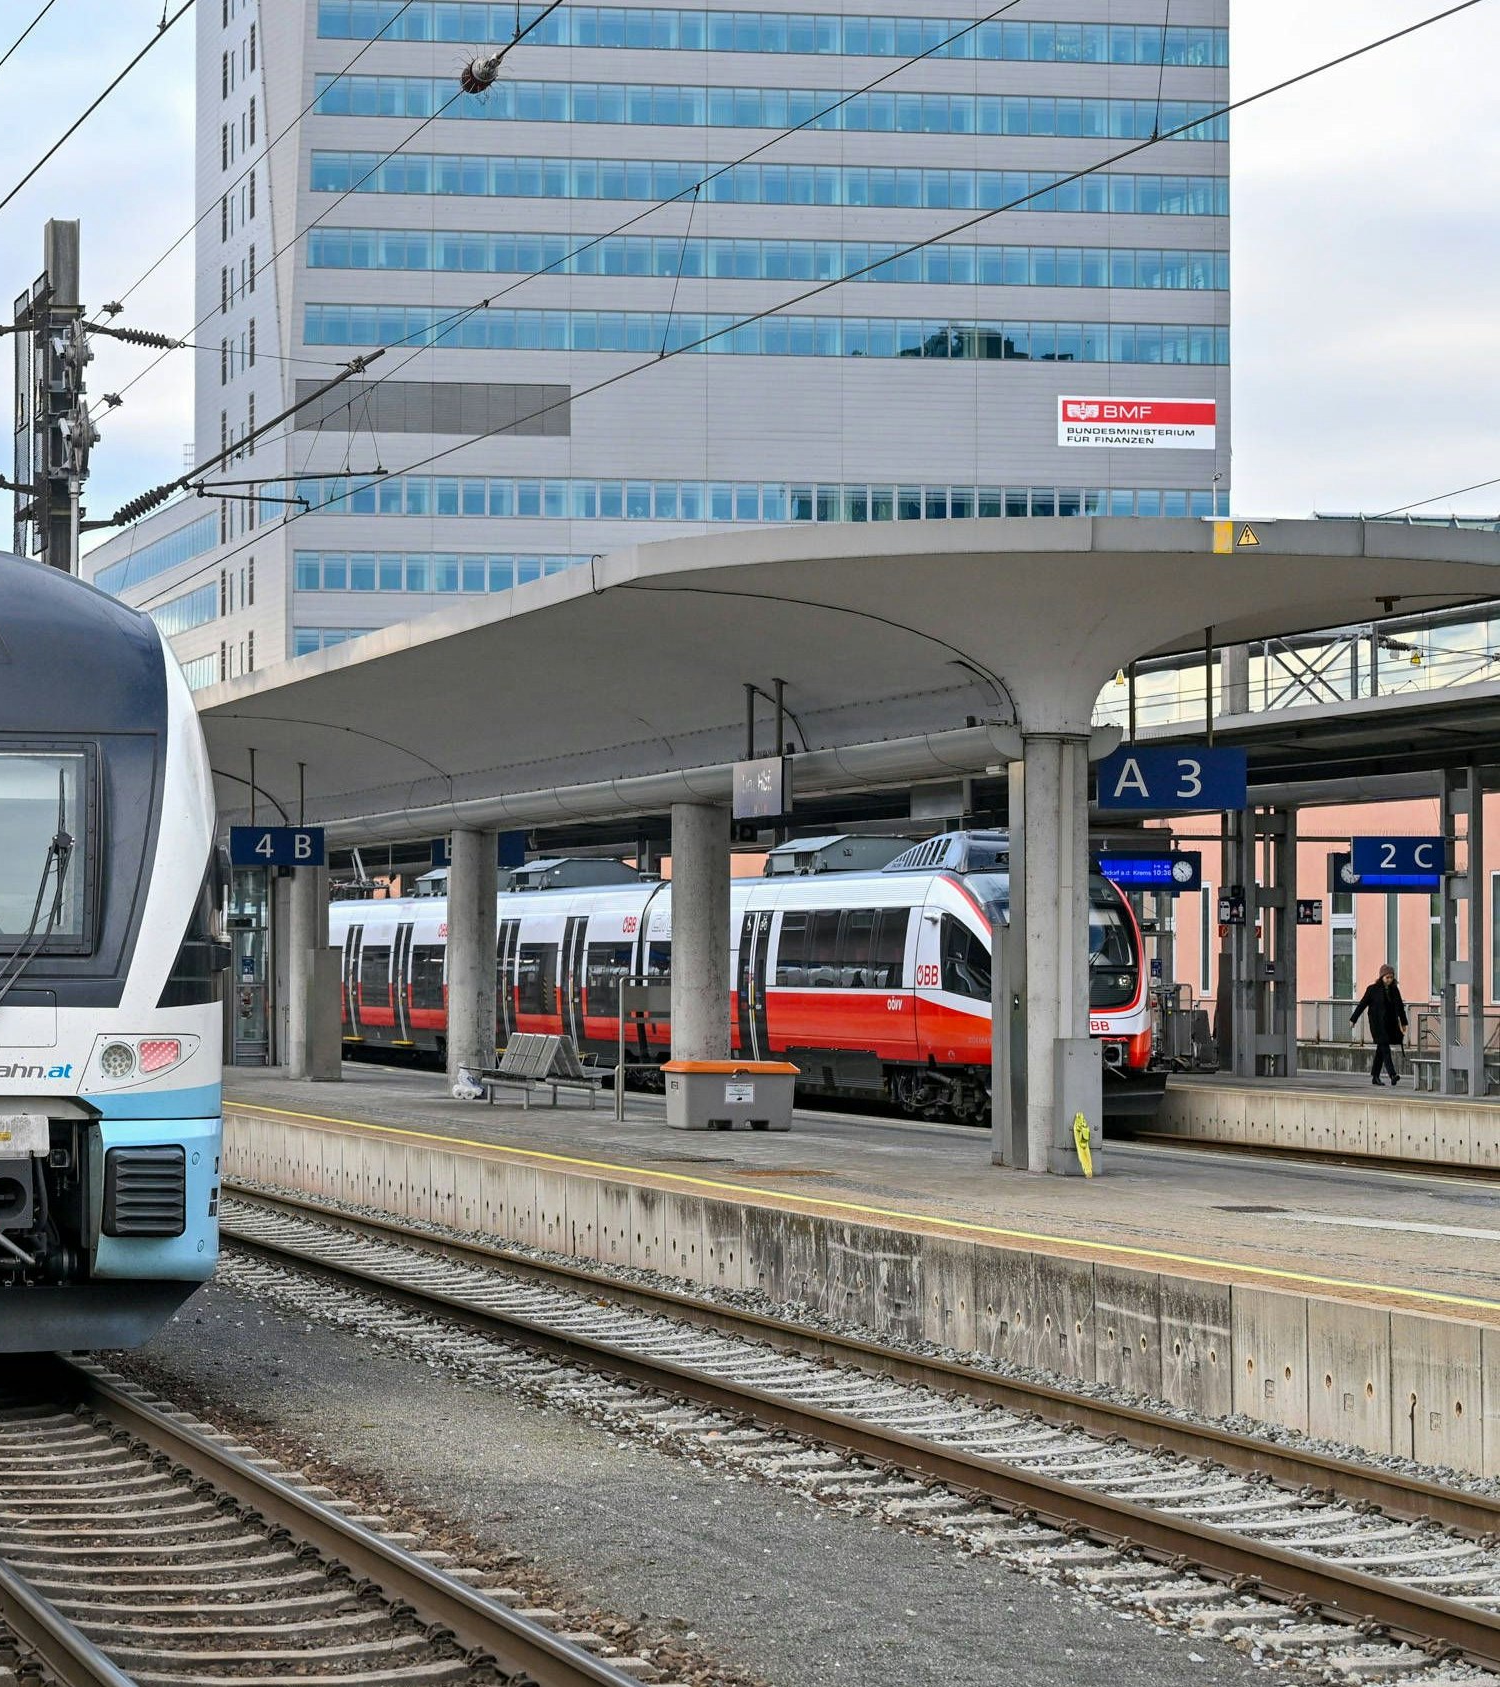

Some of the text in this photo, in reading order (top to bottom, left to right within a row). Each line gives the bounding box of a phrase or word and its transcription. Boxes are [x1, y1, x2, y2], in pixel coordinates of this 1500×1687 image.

[1103, 405, 1152, 419] BMF
[1067, 427, 1195, 437] BUNDESMINISTERIUM
[1067, 434, 1154, 444] FÜR FINANZEN
[1113, 758, 1202, 798] A 3
[255, 833, 312, 859] 4 B
[1380, 843, 1433, 869] 2 C
[916, 965, 939, 986] ÖBB
[1090, 1020, 1110, 1031] BB
